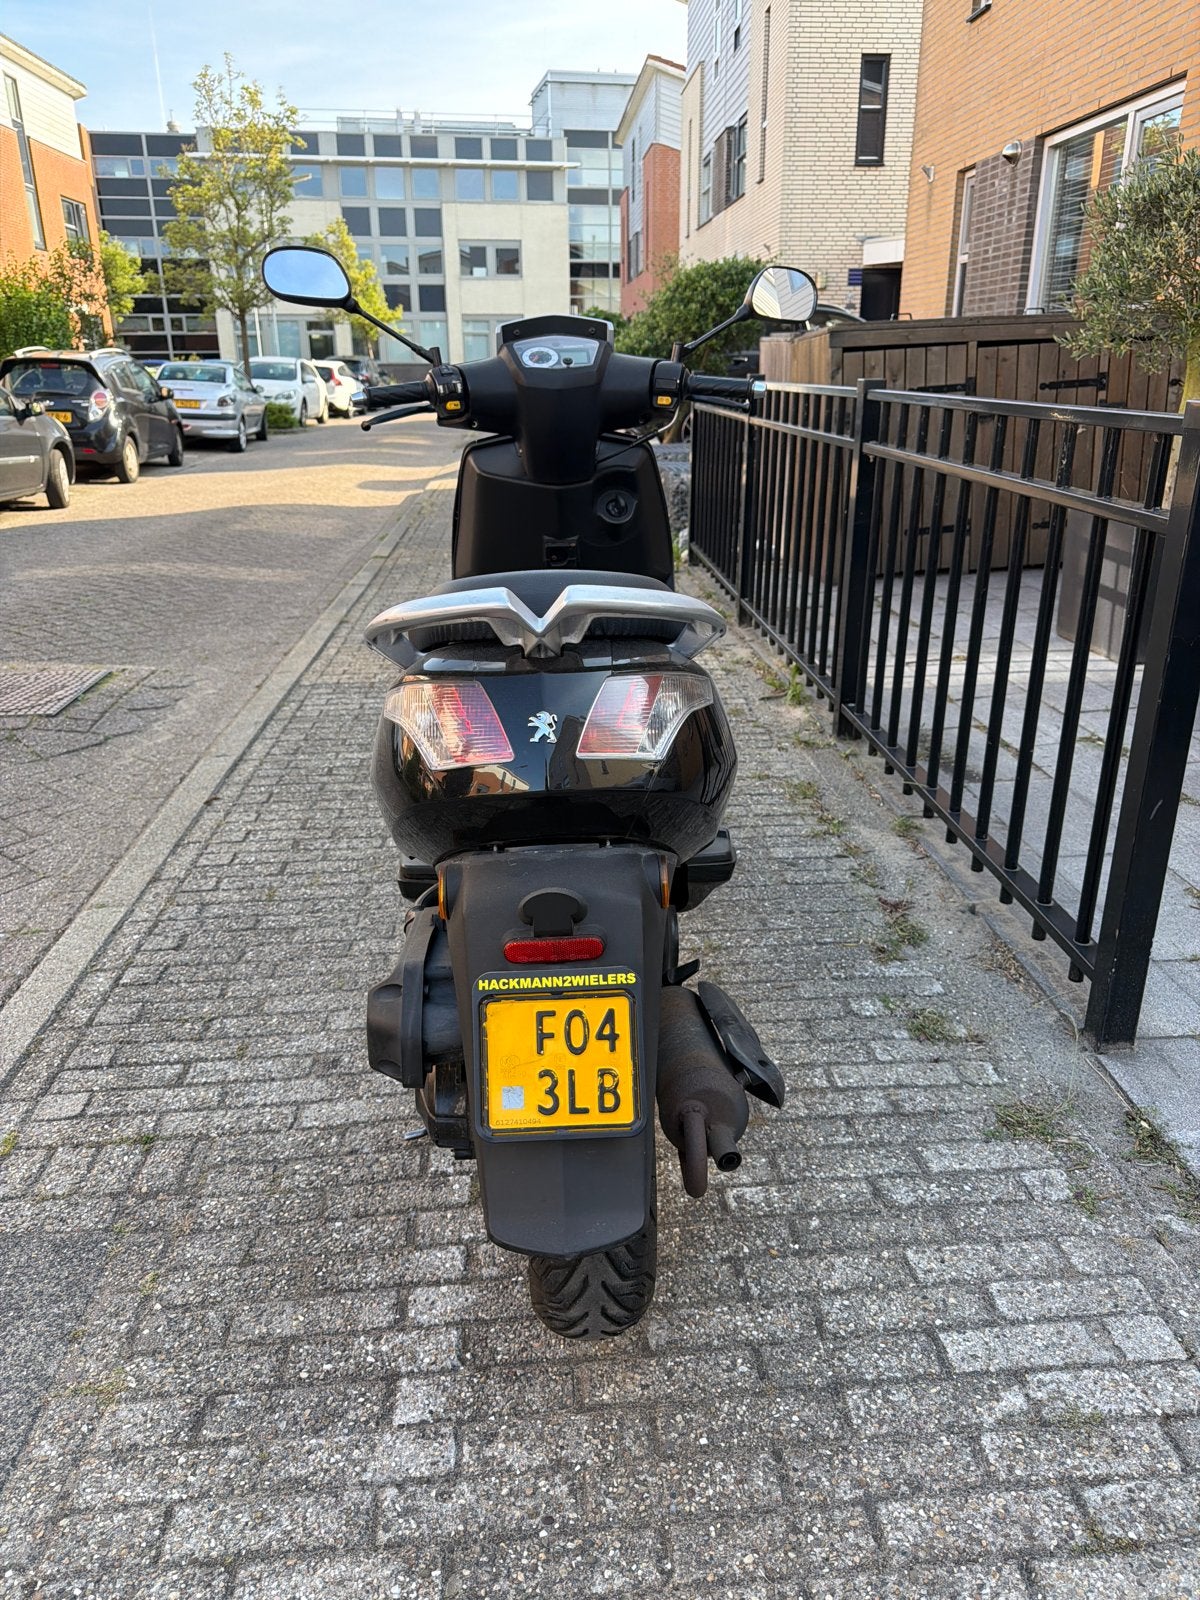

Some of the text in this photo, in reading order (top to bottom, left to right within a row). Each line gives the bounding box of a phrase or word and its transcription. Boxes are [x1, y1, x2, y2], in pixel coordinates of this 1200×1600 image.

[478, 973, 637, 990] HACKMANN2WIELERS
[535, 1008, 620, 1055] F04
[537, 1068, 621, 1116] 3LB
